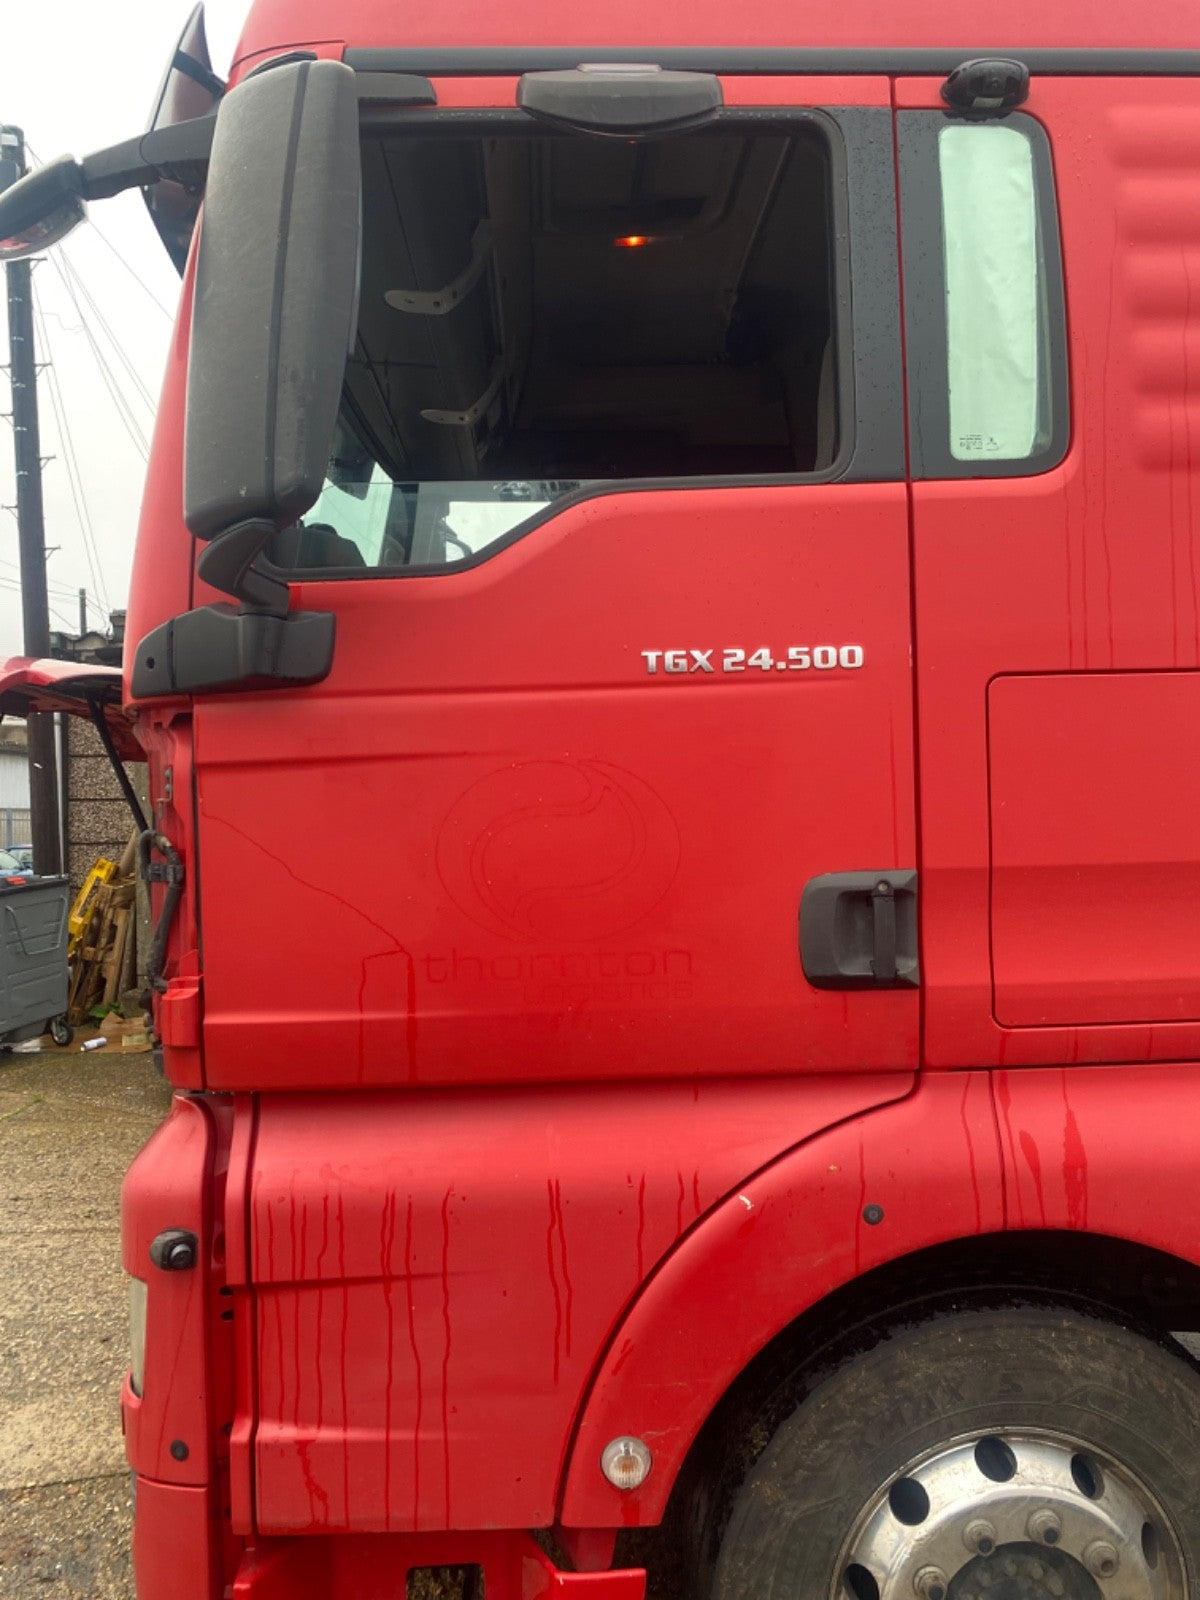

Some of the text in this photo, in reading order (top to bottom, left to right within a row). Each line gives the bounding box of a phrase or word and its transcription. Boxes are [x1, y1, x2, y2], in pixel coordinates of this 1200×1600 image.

[641, 645, 865, 674] TGX 24.500
[420, 947, 693, 983] thornton
